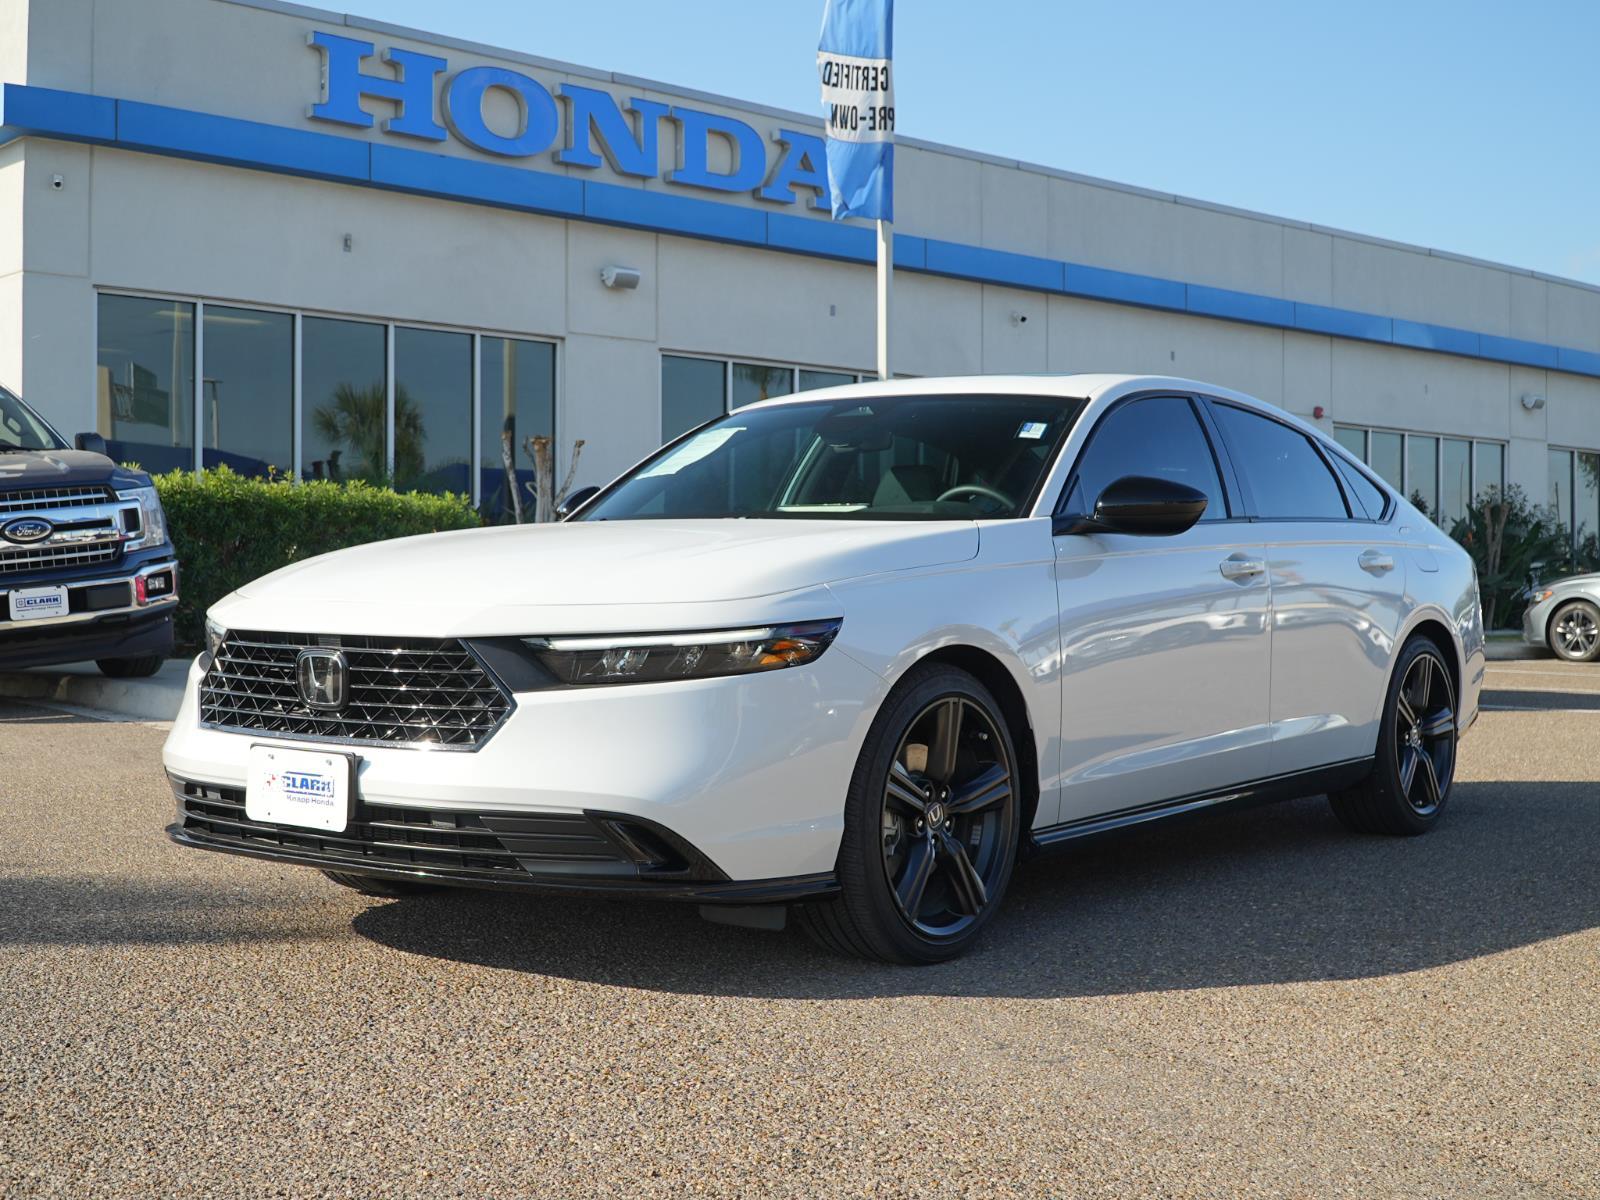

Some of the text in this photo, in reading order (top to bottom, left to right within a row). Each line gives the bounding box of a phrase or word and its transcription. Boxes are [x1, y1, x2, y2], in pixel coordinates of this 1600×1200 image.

[305, 31, 828, 211] HONDA
[16, 523, 41, 536] Ford
[26, 597, 59, 605] CLARK
[281, 776, 331, 792] CLARK
[311, 798, 334, 807] Honda
